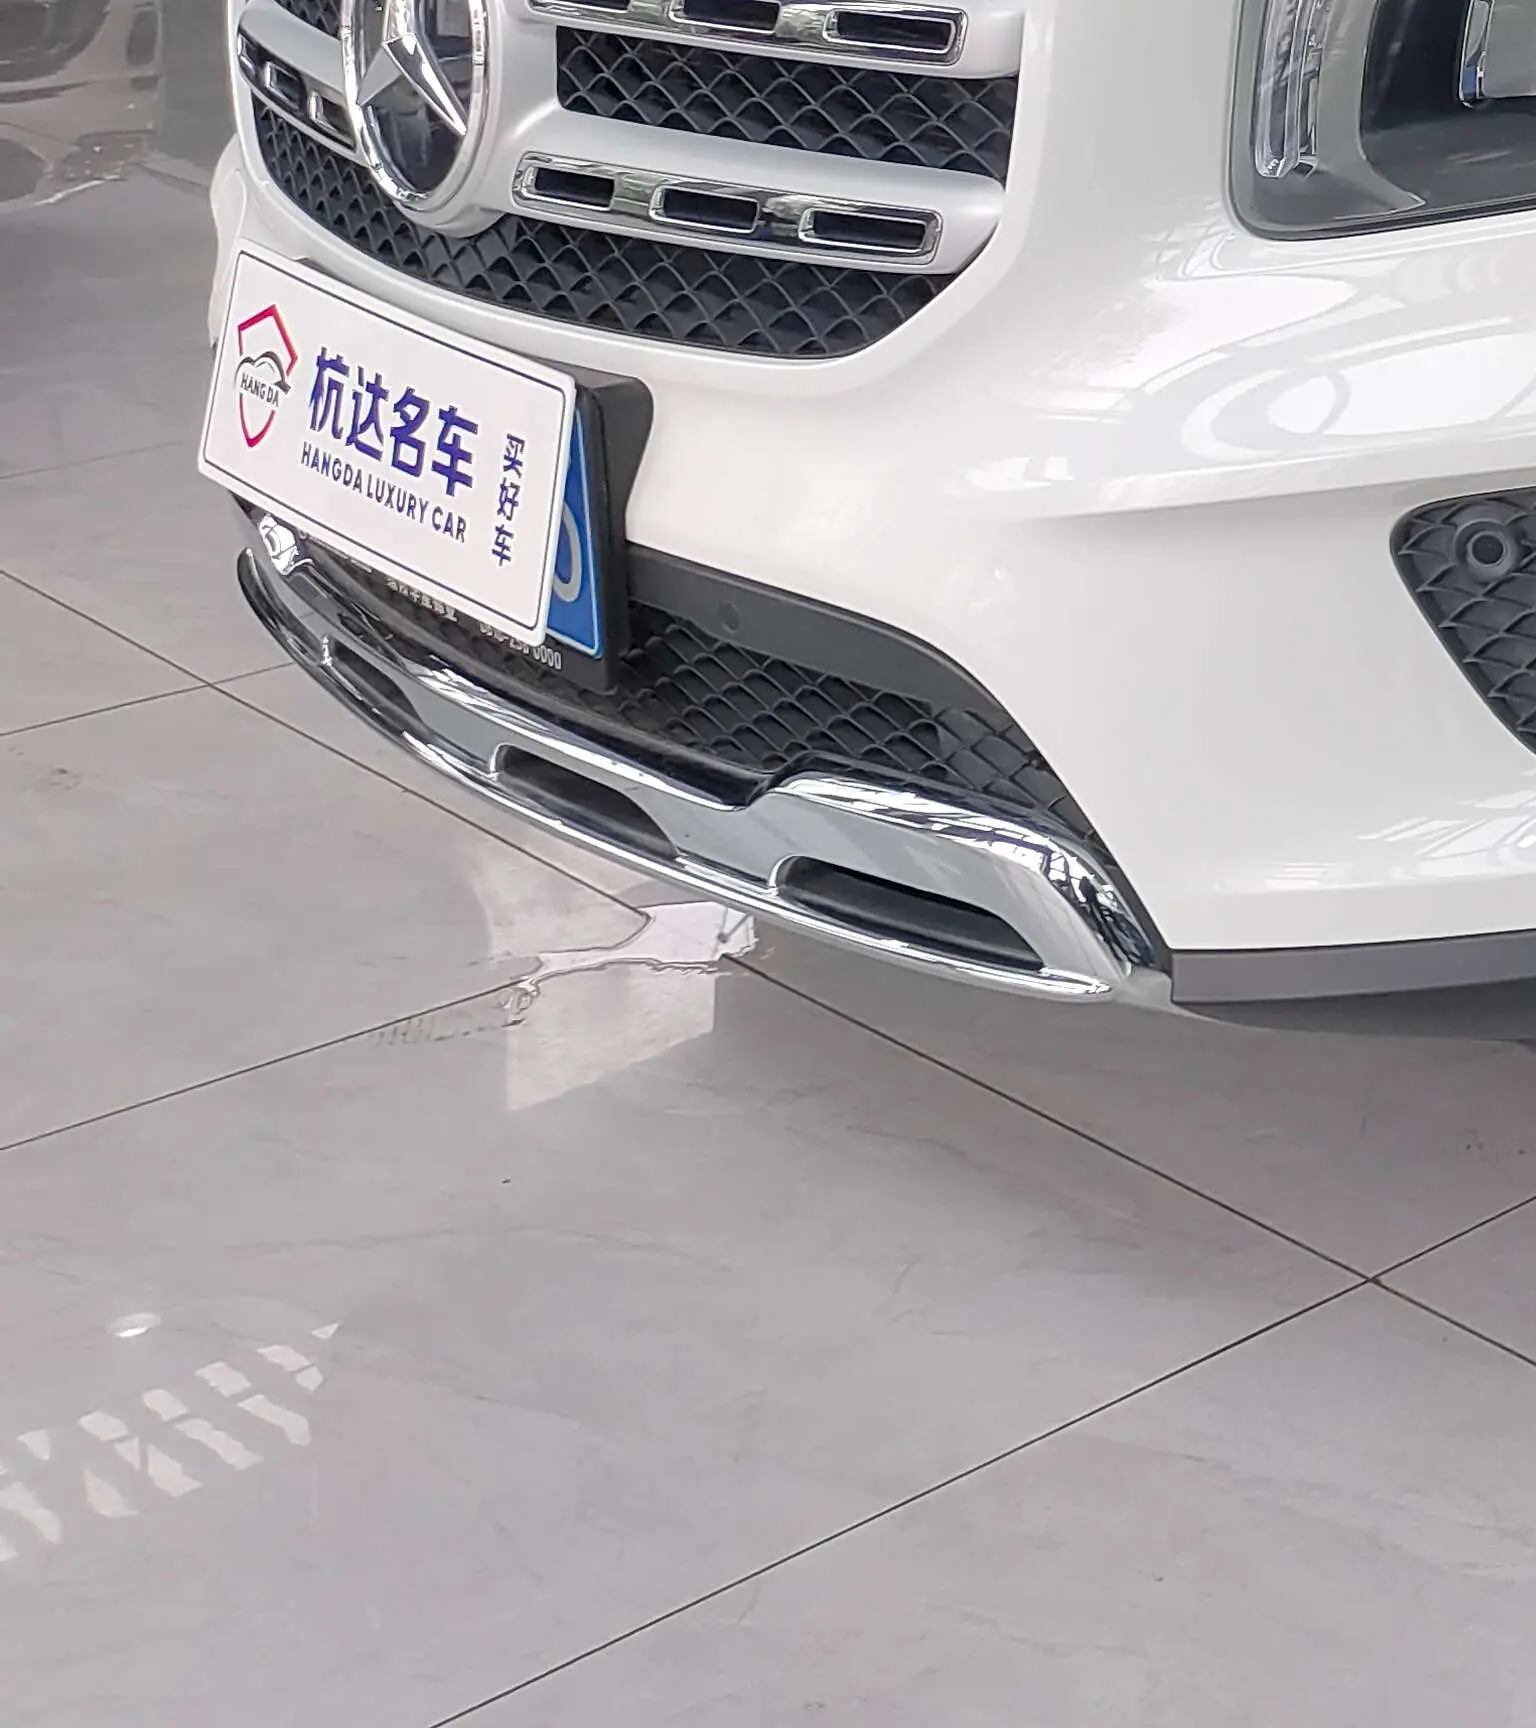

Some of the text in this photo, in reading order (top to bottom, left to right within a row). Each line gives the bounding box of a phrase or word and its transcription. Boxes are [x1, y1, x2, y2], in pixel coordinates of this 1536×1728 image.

[240, 372, 279, 407] HANG DA
[309, 346, 479, 497] 杭达名车
[300, 441, 468, 543] HANGDA LUXURY CAR
[492, 433, 526, 567] 买好车
